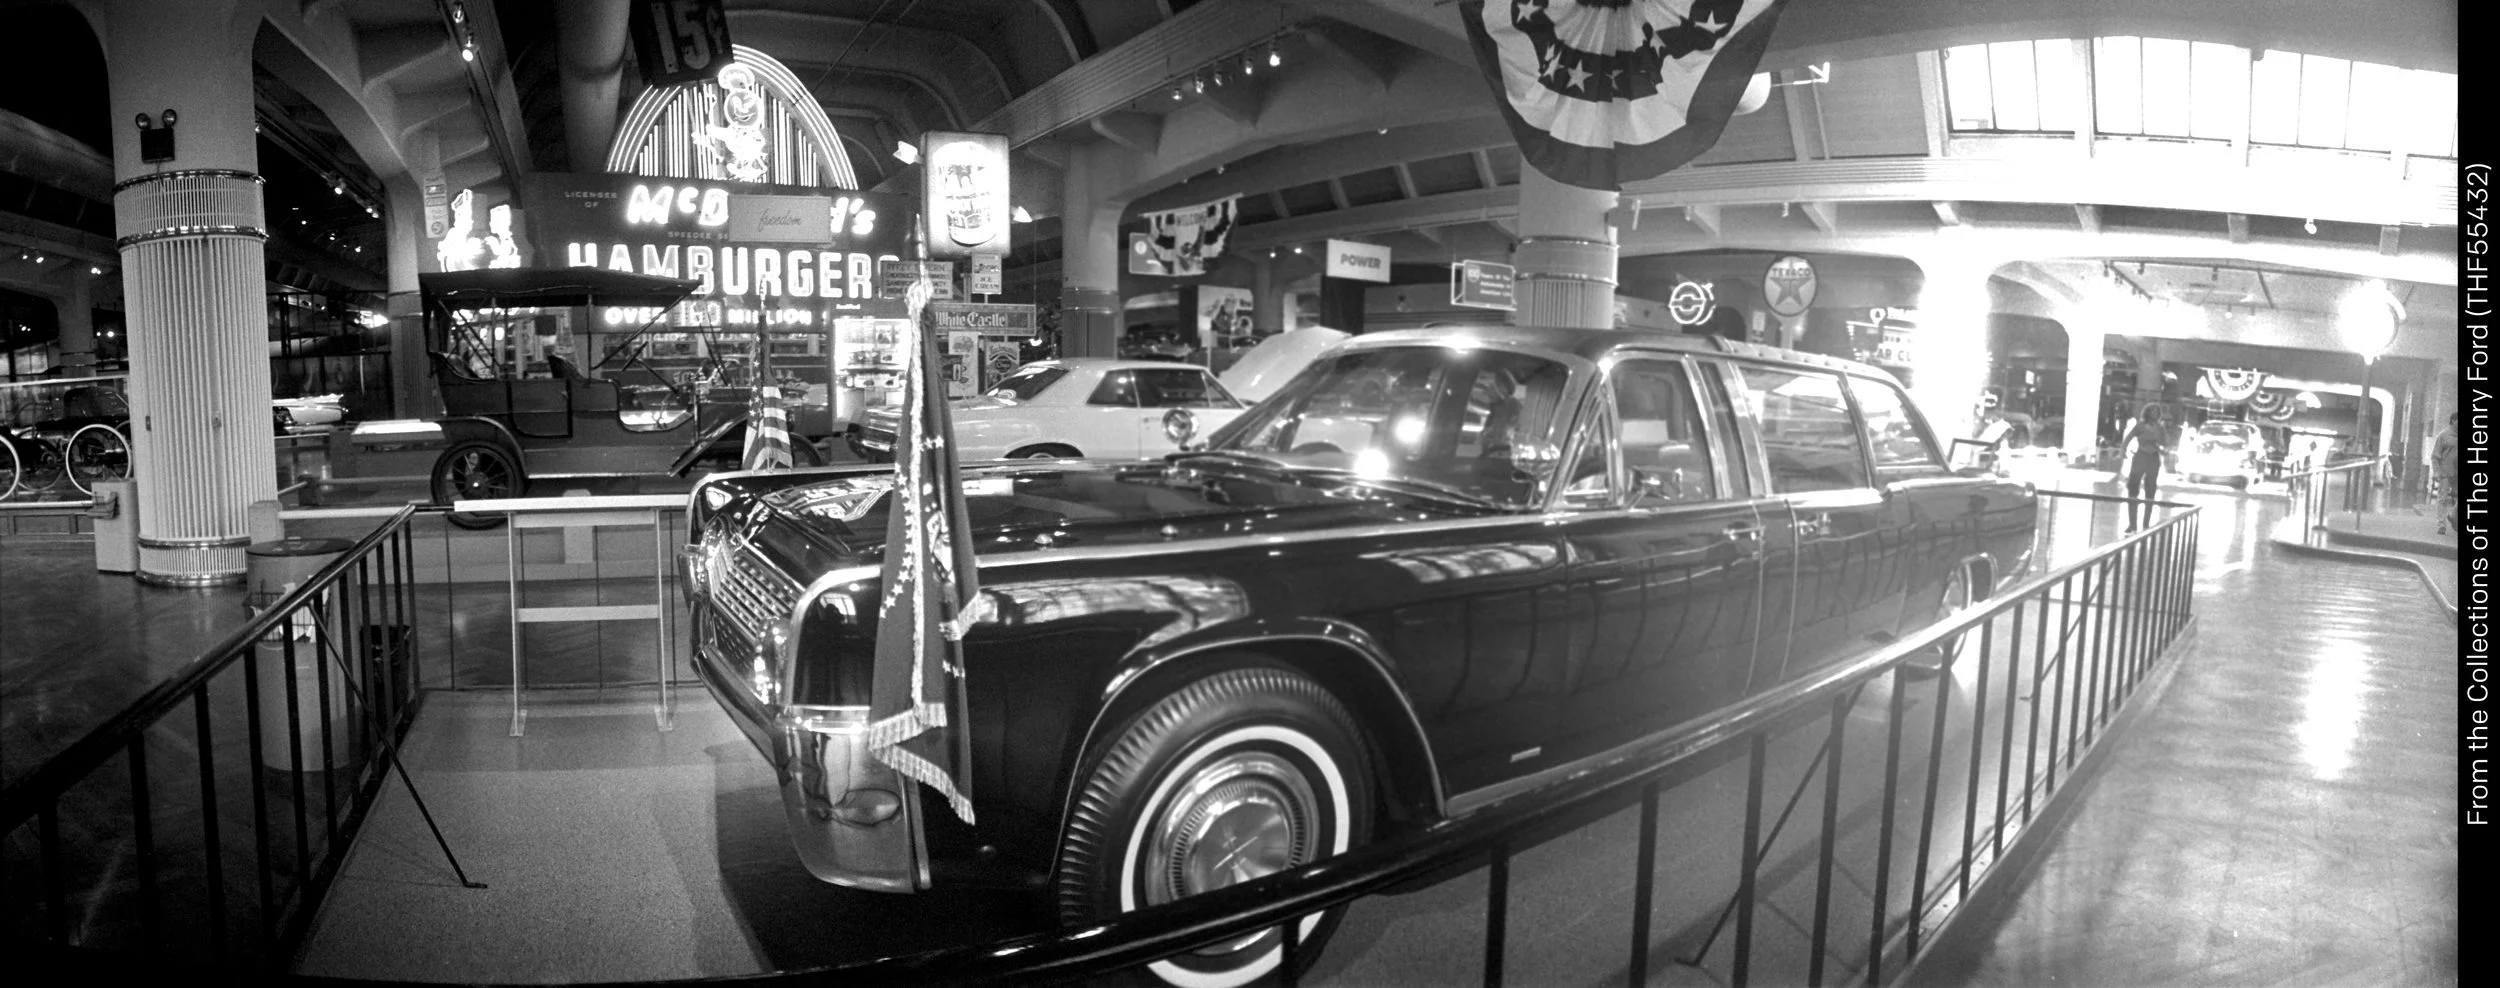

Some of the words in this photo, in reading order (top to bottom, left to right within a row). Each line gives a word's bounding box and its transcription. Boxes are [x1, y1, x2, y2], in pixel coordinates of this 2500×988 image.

[564, 191, 618, 199] LICENSEE
[756, 207, 802, 233] freedom
[1340, 252, 1382, 269] POWER
[1771, 267, 1812, 276] TEXACO
[605, 306, 668, 325] OVER
[935, 311, 966, 328] White
[967, 311, 1007, 327] Castle
